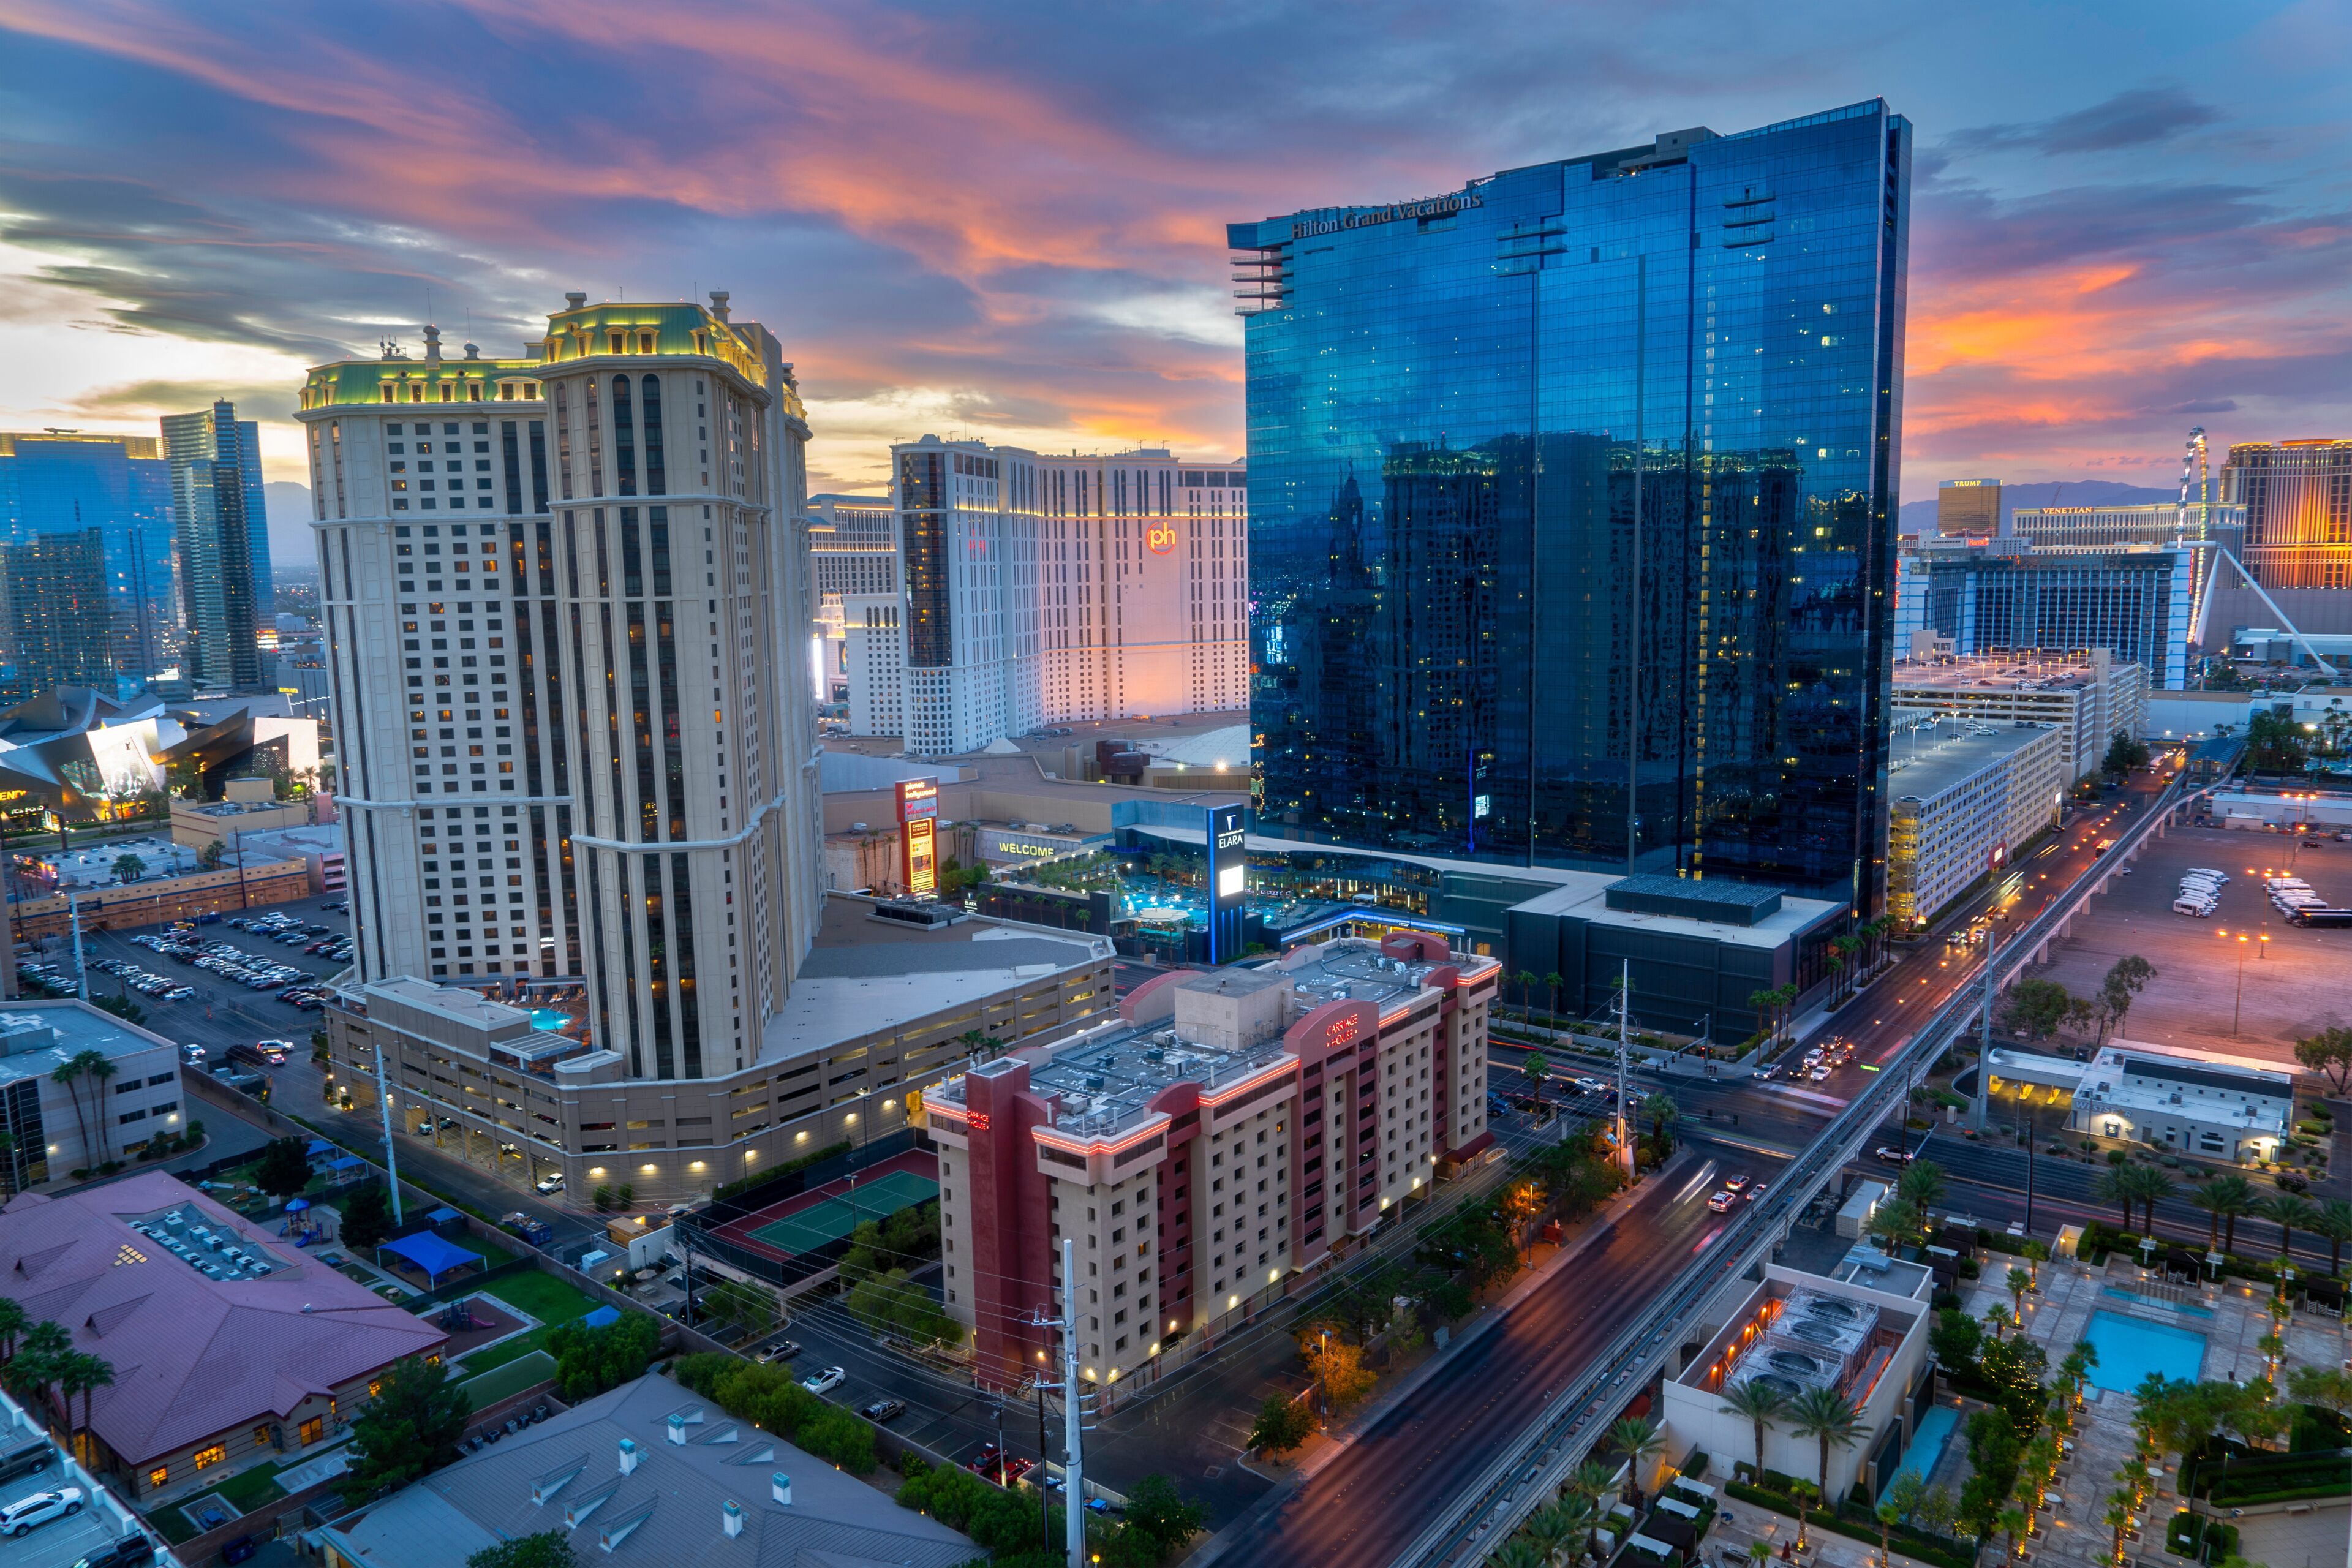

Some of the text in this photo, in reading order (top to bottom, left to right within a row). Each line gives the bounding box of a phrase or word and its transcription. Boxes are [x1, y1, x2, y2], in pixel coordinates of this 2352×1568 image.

[1291, 193, 1481, 239] Hilton Grand Vacations
[1150, 522, 1176, 549] ph
[905, 782, 925, 791] planet
[905, 787, 937, 799] hollywood
[999, 842, 1054, 857] WELCOME
[1219, 834, 1243, 849] ELARA
[1327, 1014, 1357, 1036] CARRIAGE
[1331, 1029, 1353, 1048] HOUSE
